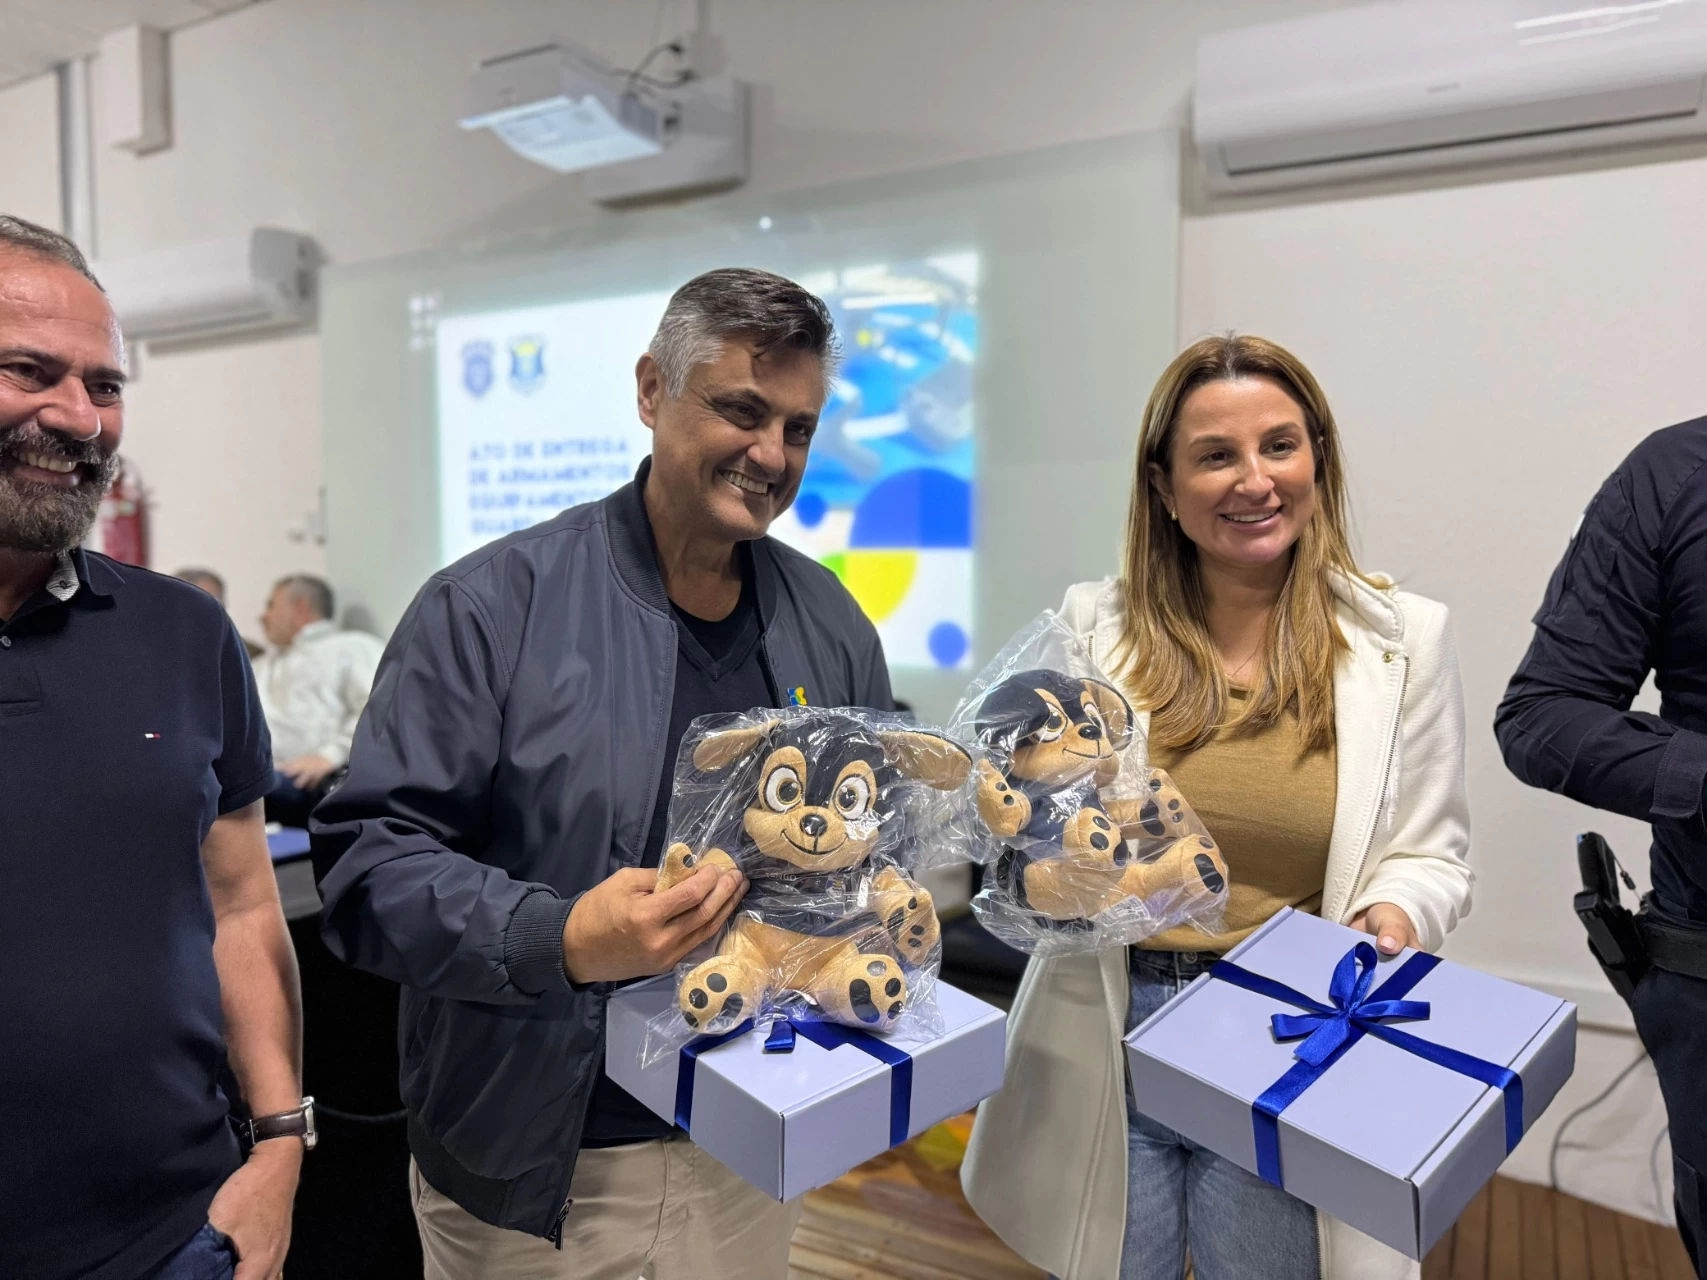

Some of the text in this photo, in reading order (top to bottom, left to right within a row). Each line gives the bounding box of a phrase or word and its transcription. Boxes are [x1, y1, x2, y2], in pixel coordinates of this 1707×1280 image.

[512, 440, 534, 458] DE
[542, 436, 629, 458] ENTREGA
[470, 461, 631, 485] DE ARMAMENTOS
